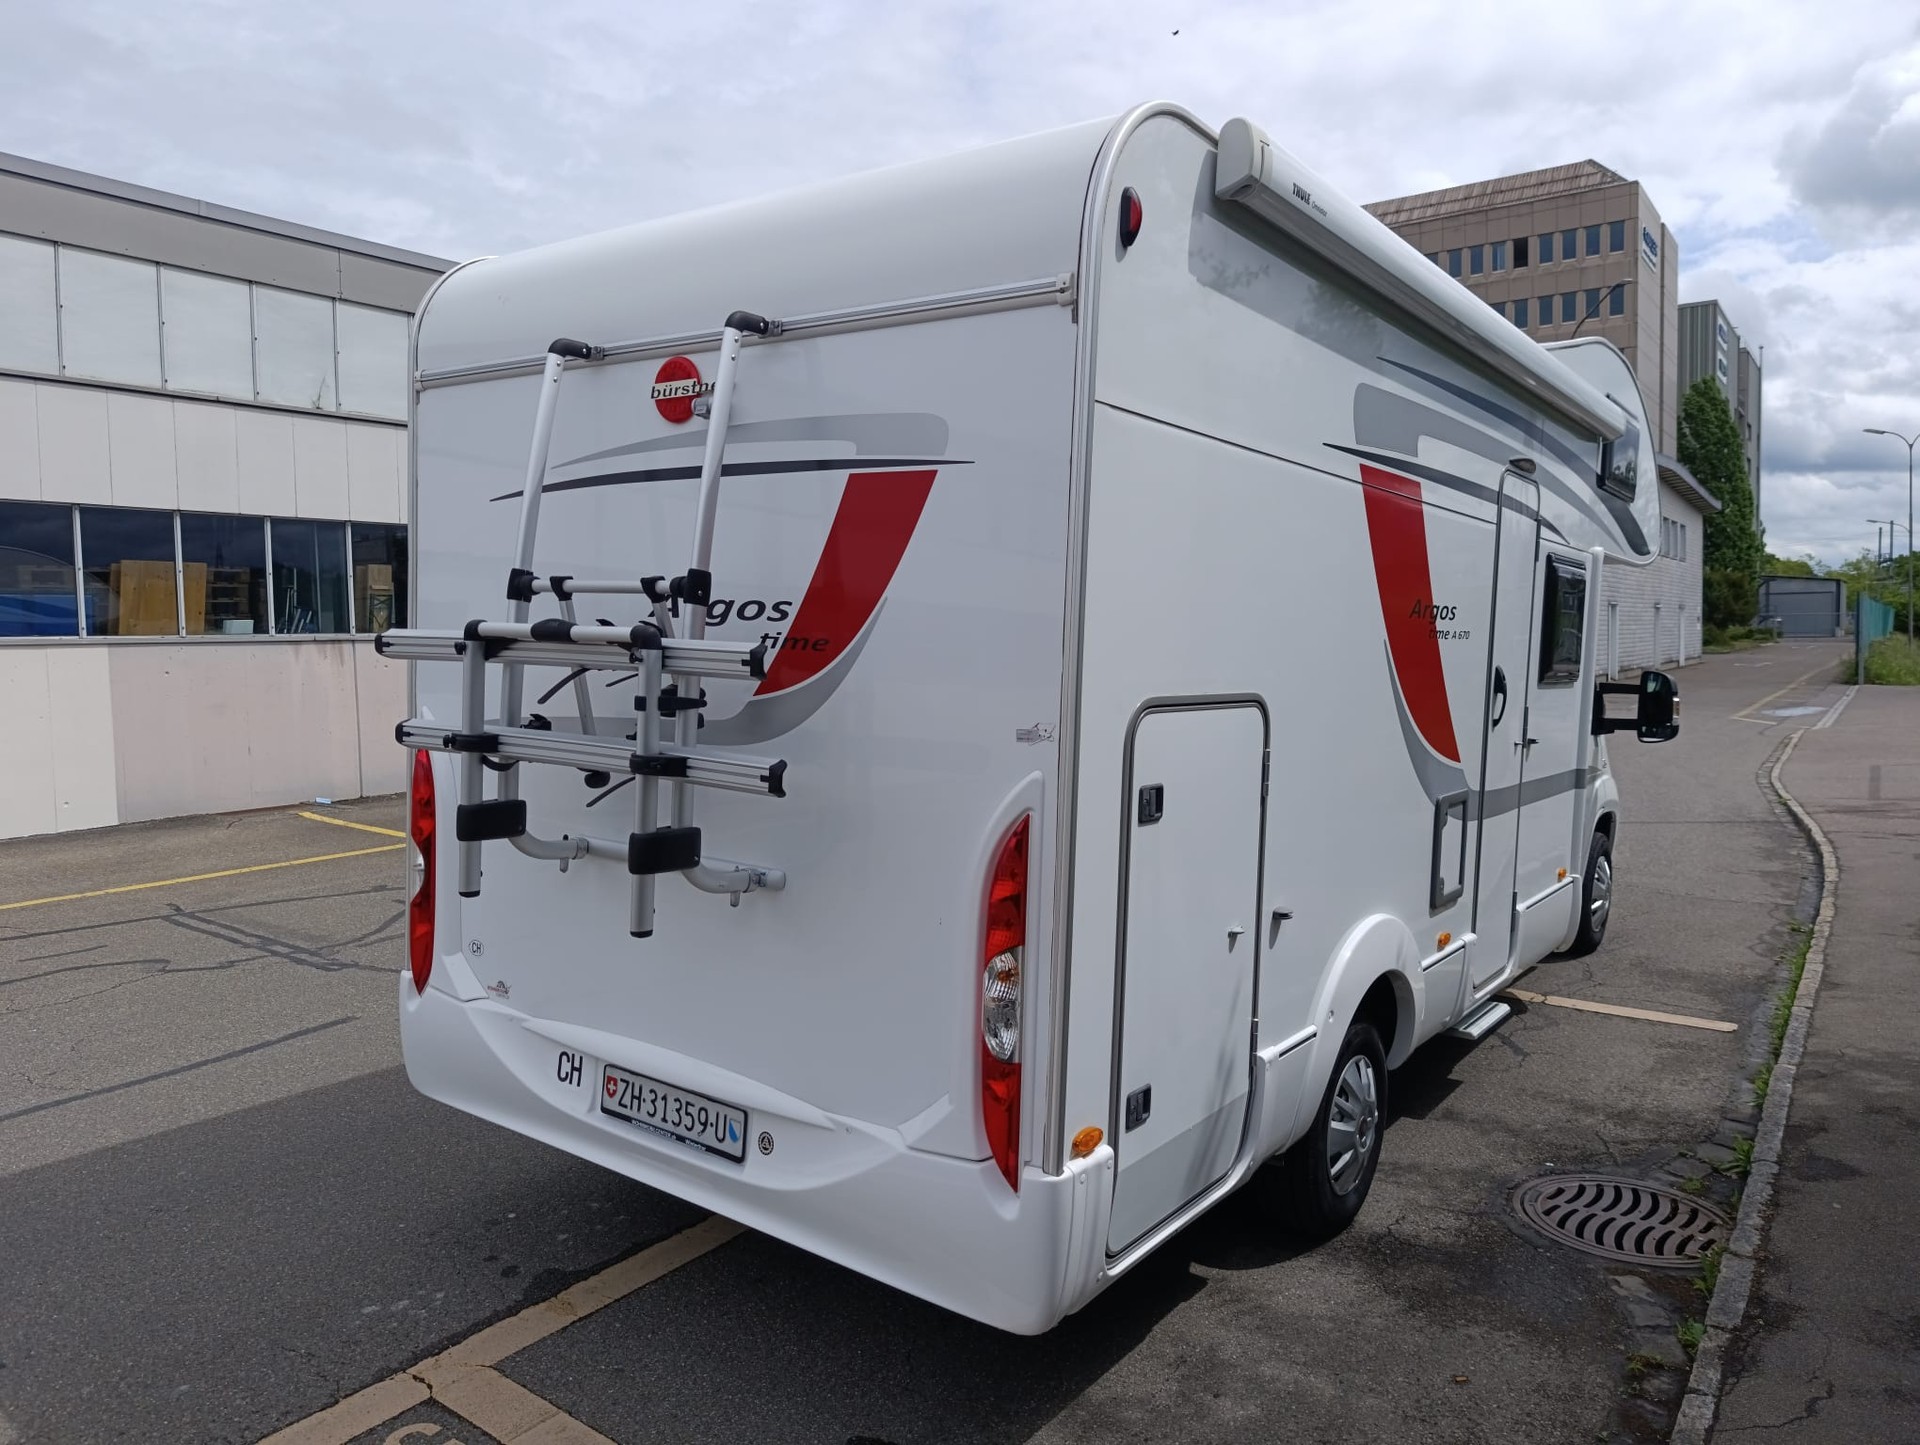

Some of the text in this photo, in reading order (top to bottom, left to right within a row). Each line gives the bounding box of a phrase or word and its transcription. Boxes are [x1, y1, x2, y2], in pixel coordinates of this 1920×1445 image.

[1292, 182, 1311, 205] THULE
[650, 381, 716, 399] bürstn
[1408, 599, 1457, 625] Argos
[760, 632, 830, 652] time
[1451, 631, 1457, 640] A
[471, 942, 482, 954] CH
[557, 1051, 584, 1087] CH
